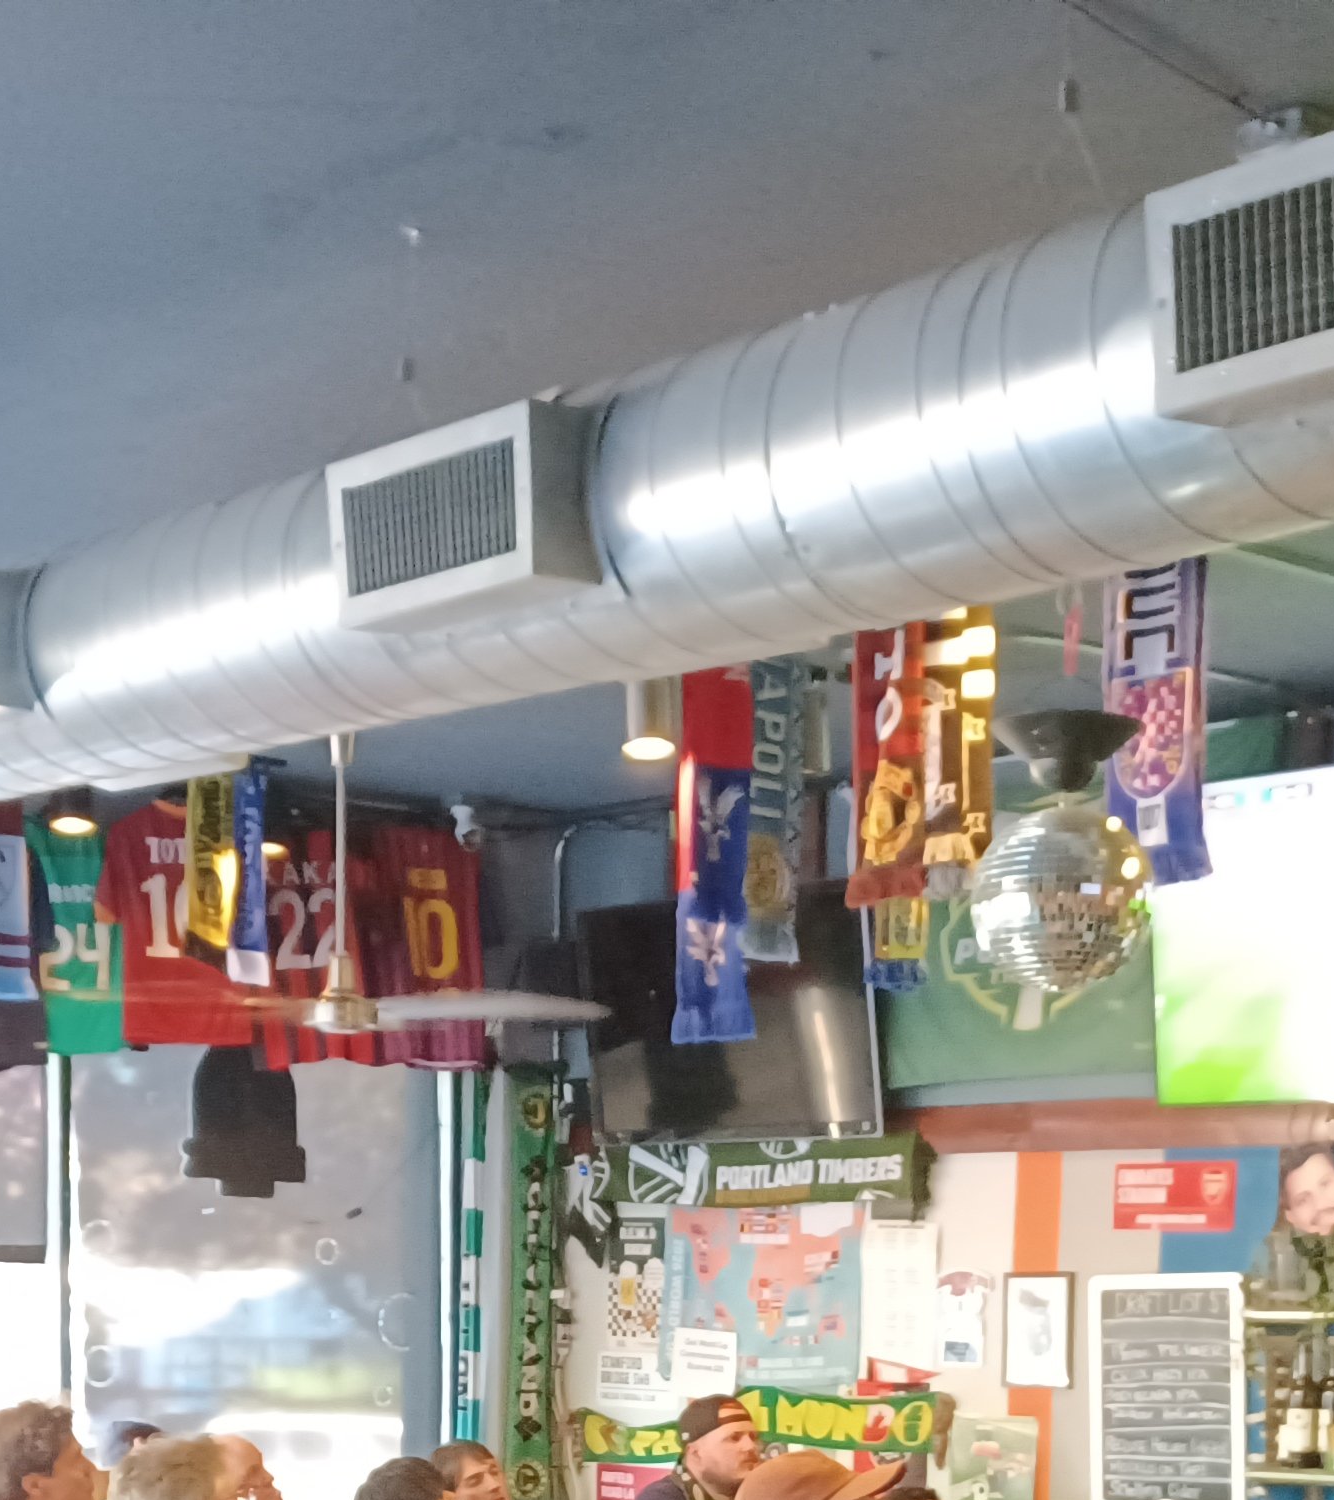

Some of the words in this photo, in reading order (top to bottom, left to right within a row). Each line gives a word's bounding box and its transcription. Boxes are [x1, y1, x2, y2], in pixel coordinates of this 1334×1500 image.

[38, 921, 111, 992] 24
[269, 888, 337, 971] 22
[716, 1158, 814, 1191] PORTLAND
[817, 1153, 904, 1185] TIMBERS
